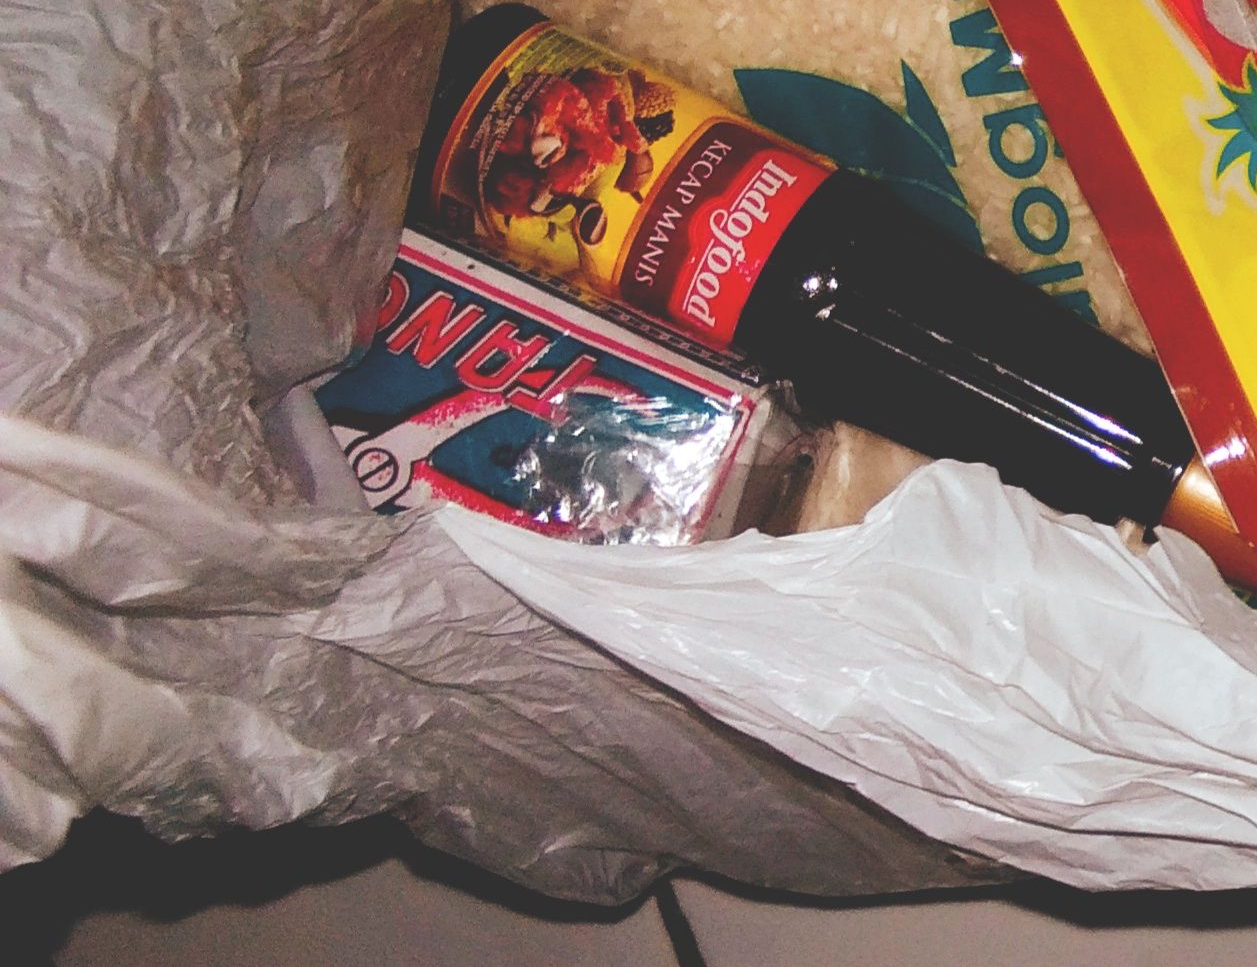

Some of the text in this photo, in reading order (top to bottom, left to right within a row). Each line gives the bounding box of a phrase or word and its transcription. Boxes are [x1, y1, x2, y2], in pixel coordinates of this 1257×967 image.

[634, 139, 733, 286] KECAP MANIS
[683, 159, 798, 327] Indofood
